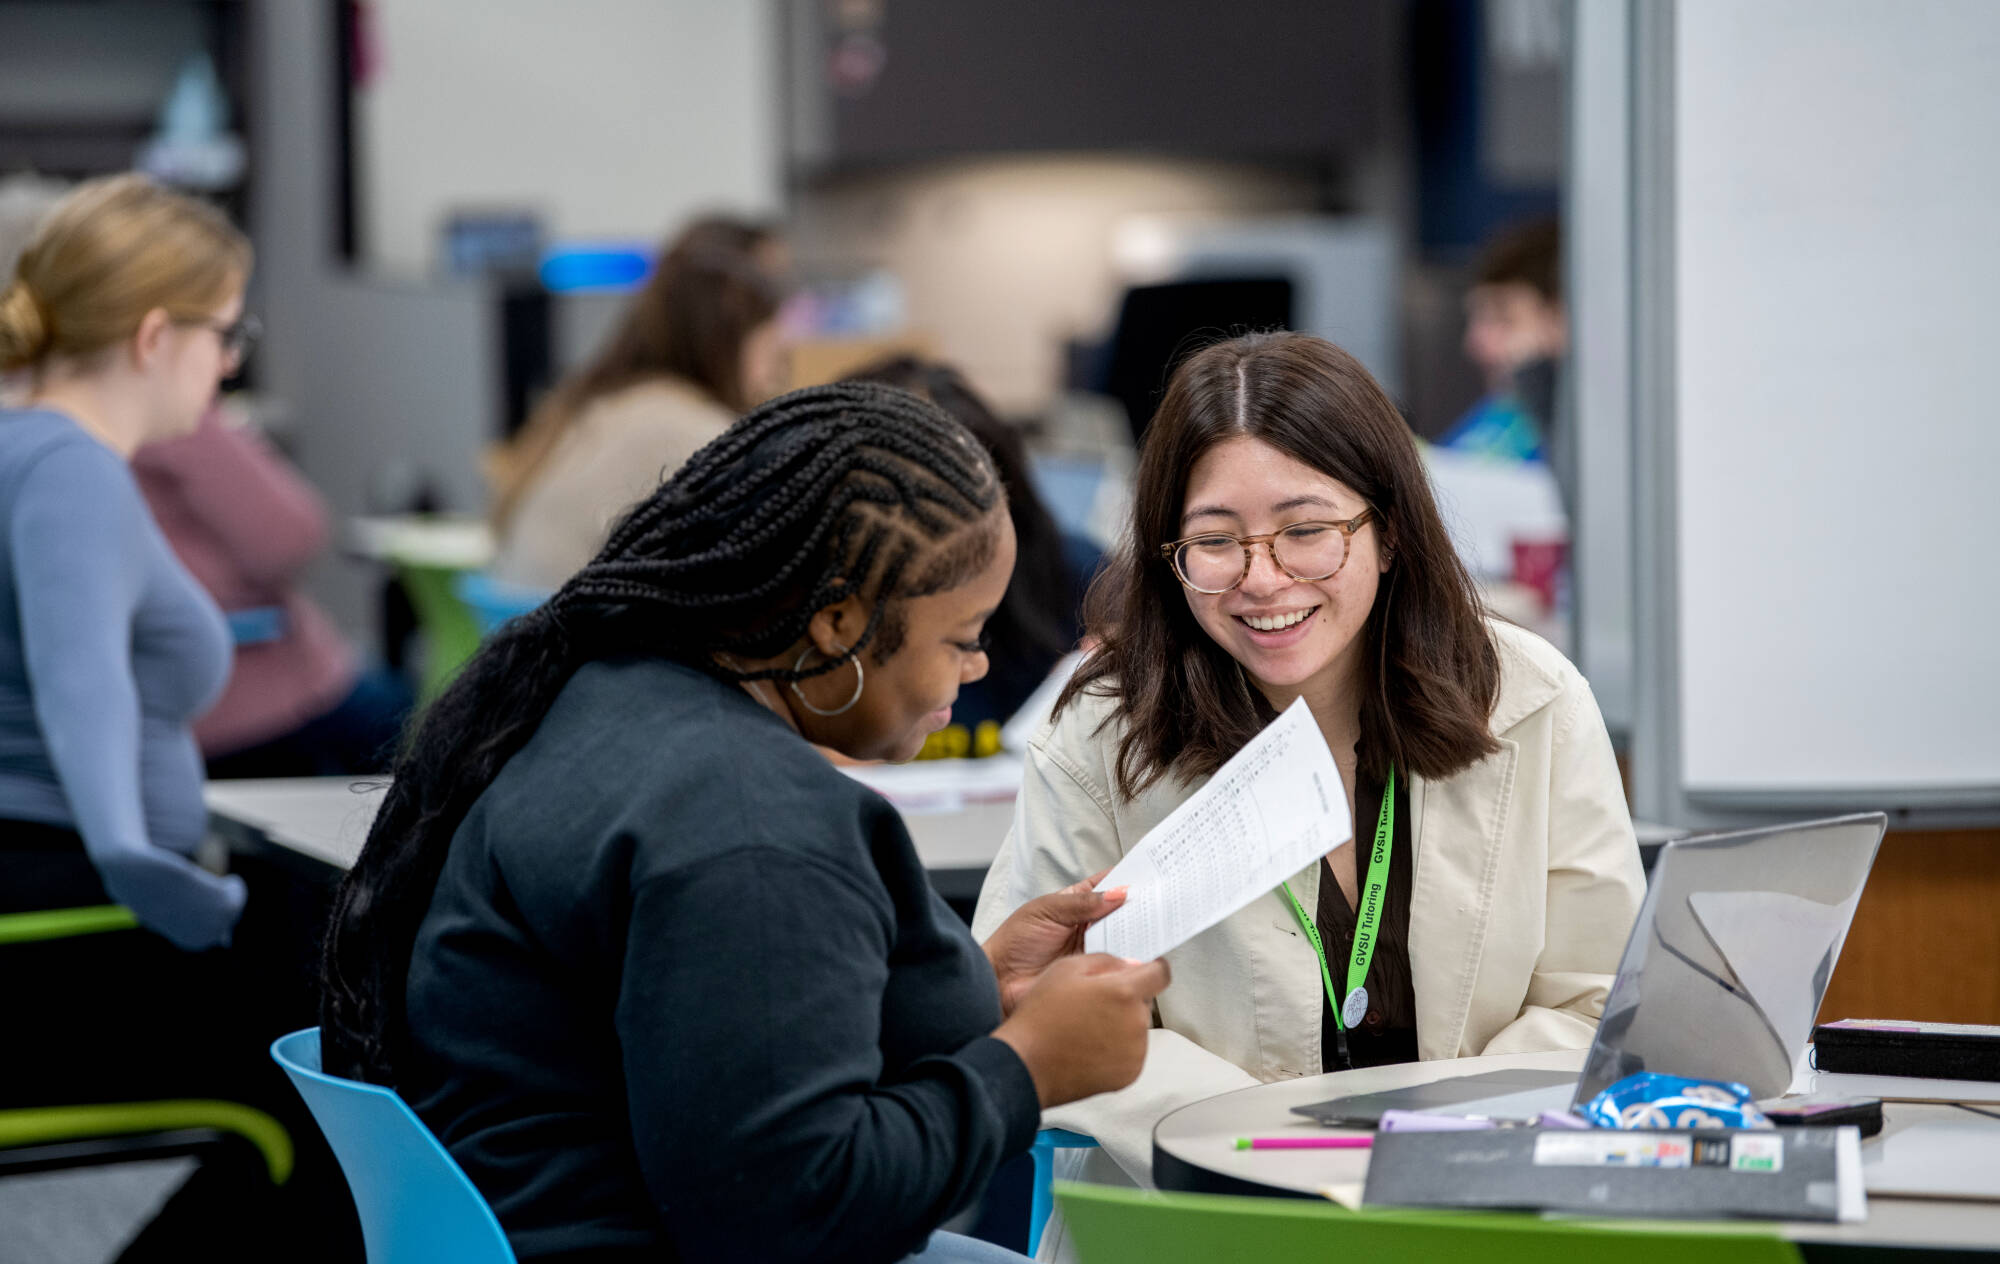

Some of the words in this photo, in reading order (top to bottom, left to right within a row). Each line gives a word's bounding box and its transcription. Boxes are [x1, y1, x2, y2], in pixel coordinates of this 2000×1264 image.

[1374, 831, 1386, 864] GVSU
[1362, 883, 1382, 929] Tutoring
[1355, 933, 1370, 966] GVSU
